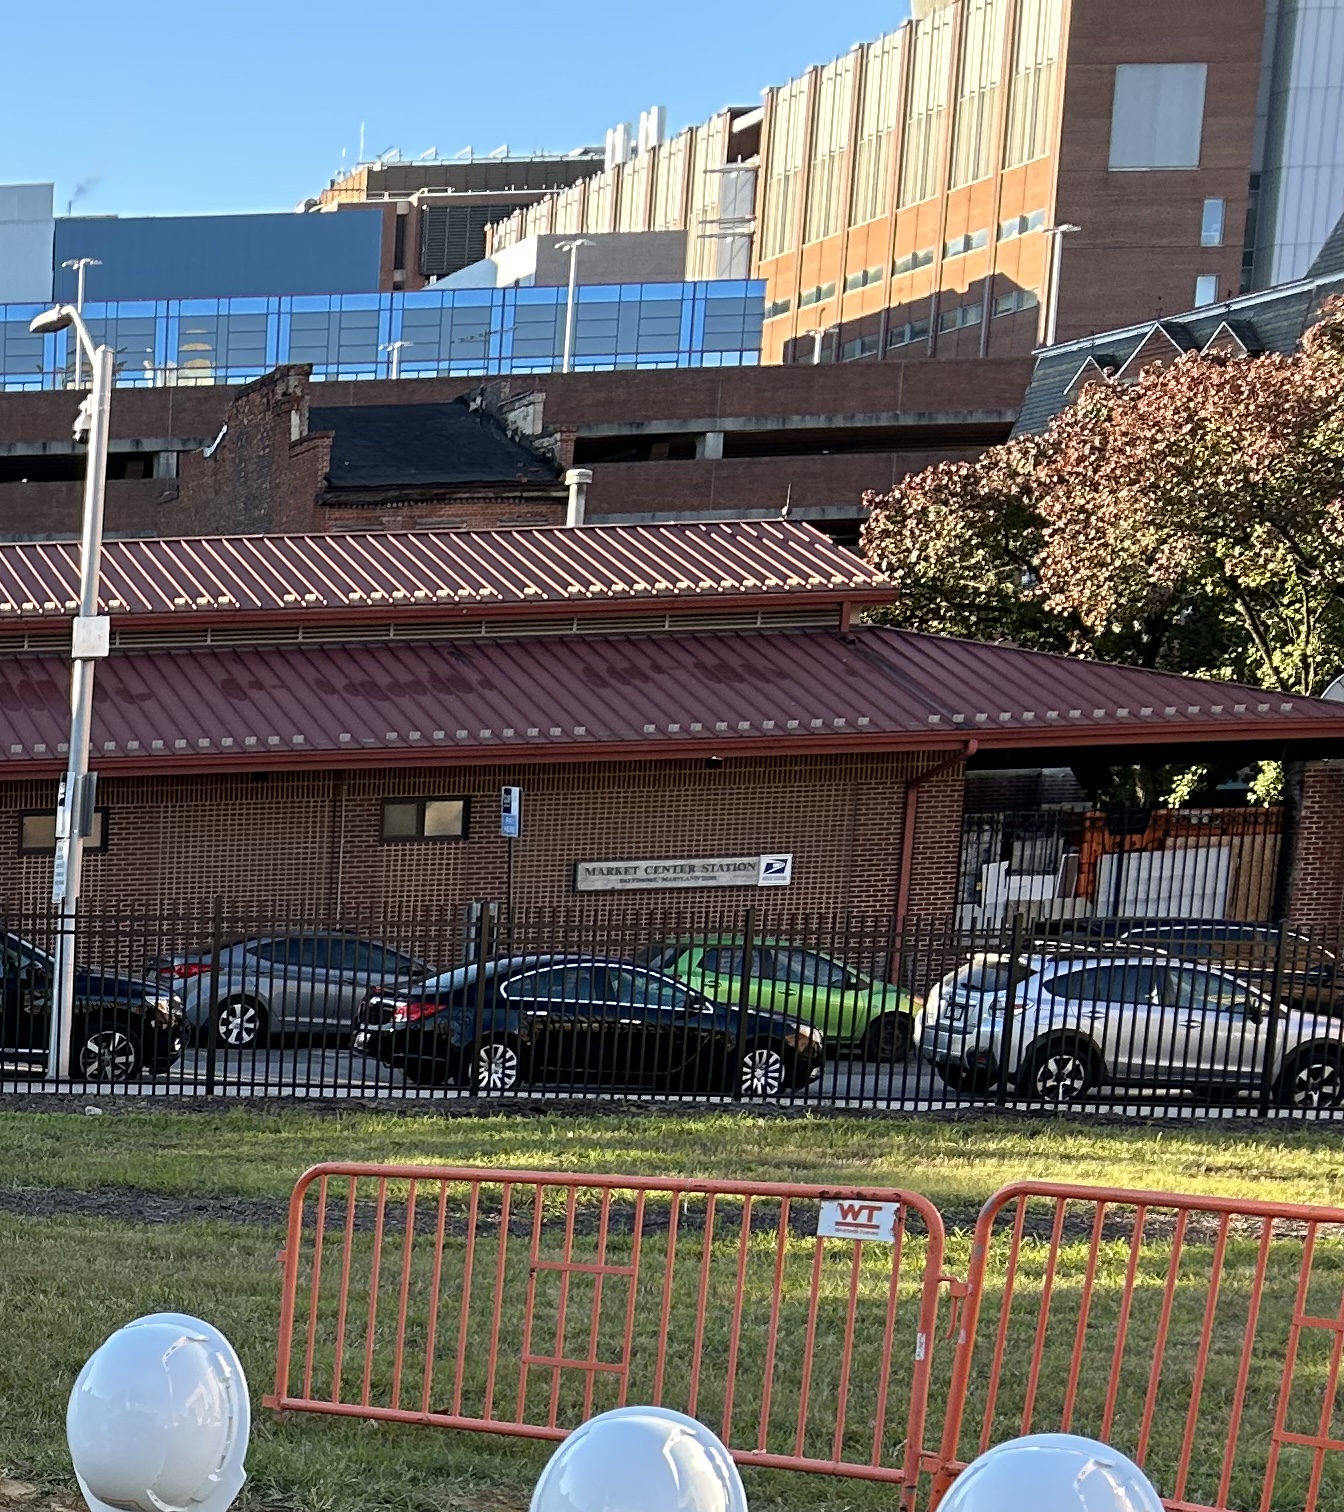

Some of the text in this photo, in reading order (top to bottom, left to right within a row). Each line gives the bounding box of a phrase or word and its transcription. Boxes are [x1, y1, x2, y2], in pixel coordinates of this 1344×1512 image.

[584, 862, 757, 877] MARKET CENTER STATION
[837, 1202, 883, 1223] WT
